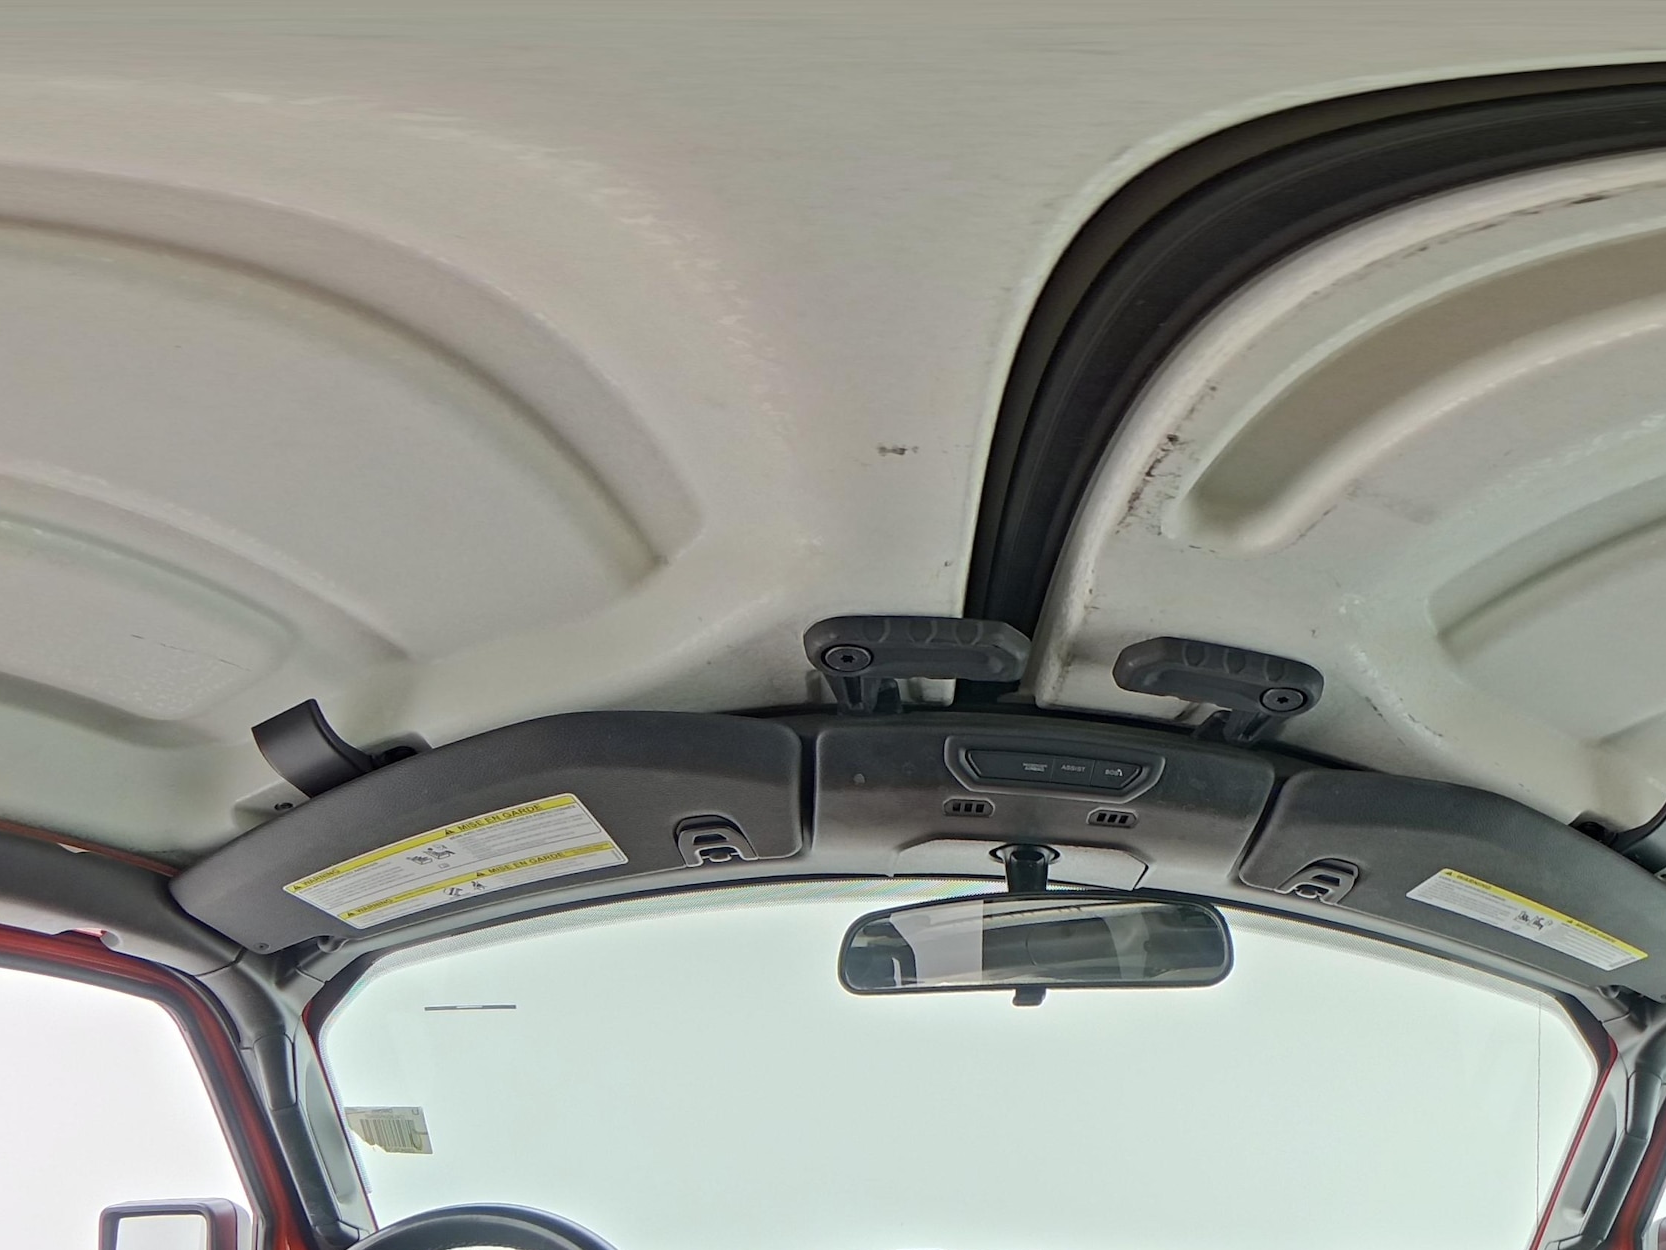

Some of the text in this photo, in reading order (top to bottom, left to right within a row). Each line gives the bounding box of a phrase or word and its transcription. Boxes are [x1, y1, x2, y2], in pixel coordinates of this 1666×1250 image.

[1061, 764, 1086, 772] ASSIST
[457, 818, 484, 831] MISE
[485, 814, 500, 825] EN
[501, 804, 541, 819] GARDE
[488, 852, 566, 873] MISE EN GARDE
